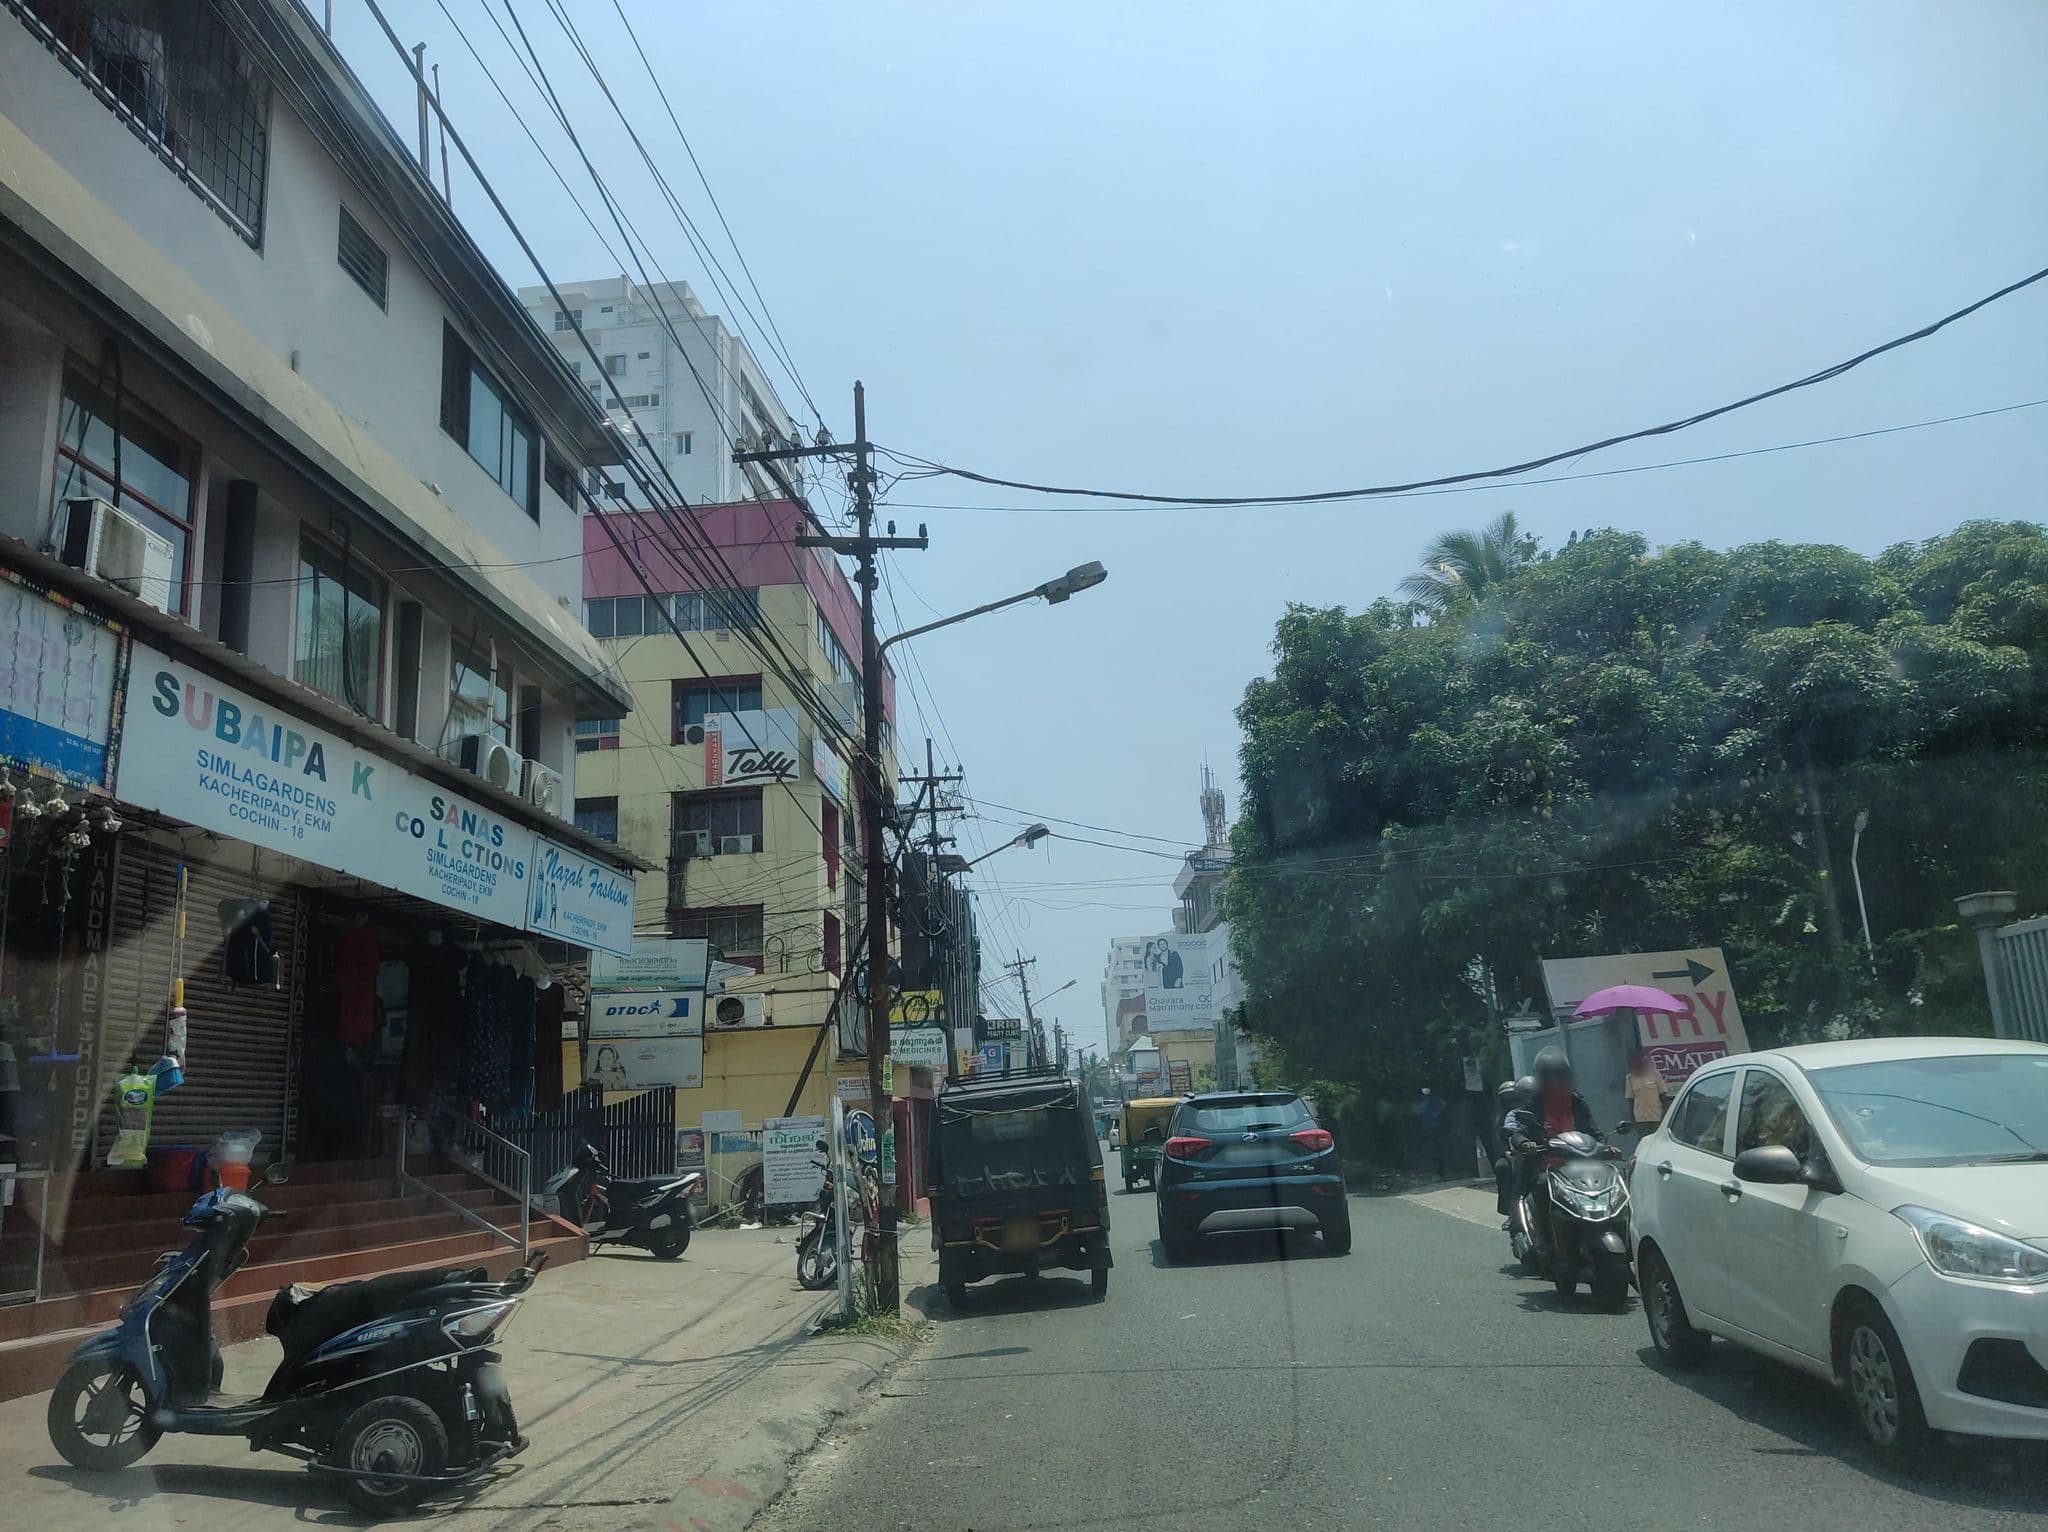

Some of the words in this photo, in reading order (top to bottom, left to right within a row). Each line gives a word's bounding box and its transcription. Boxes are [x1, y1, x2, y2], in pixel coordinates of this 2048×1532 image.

[152, 671, 327, 782] SUBAIPA
[351, 761, 375, 801] K
[726, 747, 797, 778] Tally
[197, 750, 336, 816] SIMLAGARDENS
[199, 773, 300, 825] KACHERIPADY,
[304, 813, 331, 833] EKM
[229, 803, 280, 832] COCHIN
[291, 825, 304, 839] 18
[430, 796, 504, 847] SANAS
[426, 847, 497, 886] SIMLAGARDENS
[441, 883, 467, 902] COCHIN
[478, 883, 493, 897] EKM
[588, 868, 629, 907] Fashion
[605, 1004, 650, 1016] DTDC
[899, 1046, 942, 1054] MEDICINES
